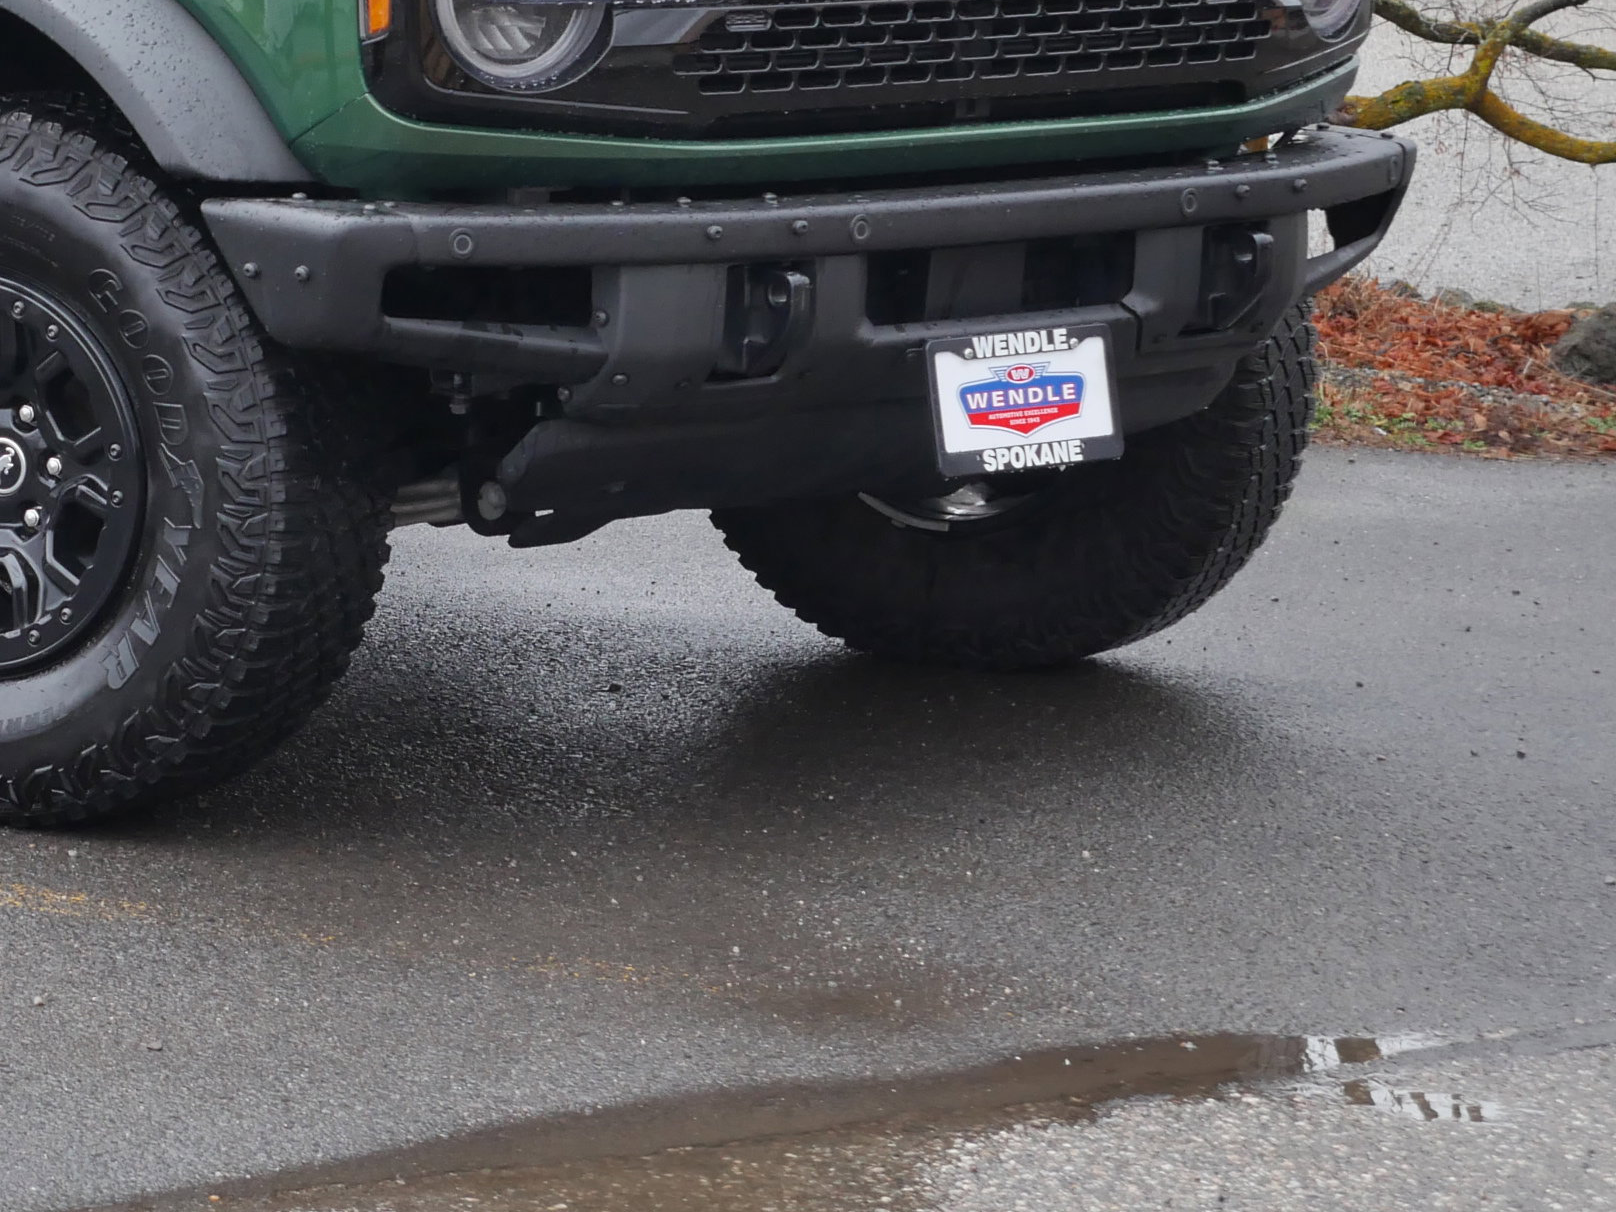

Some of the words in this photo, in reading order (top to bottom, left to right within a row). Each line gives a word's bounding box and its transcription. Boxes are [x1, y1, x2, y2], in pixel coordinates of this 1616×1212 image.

[972, 328, 1068, 358] WENDLE
[967, 383, 1076, 409] WENDLE
[989, 410, 1023, 419] AUTOMOTIVE
[1024, 407, 1058, 416] EXCELLENCE
[983, 439, 1084, 472] SPOKANE
